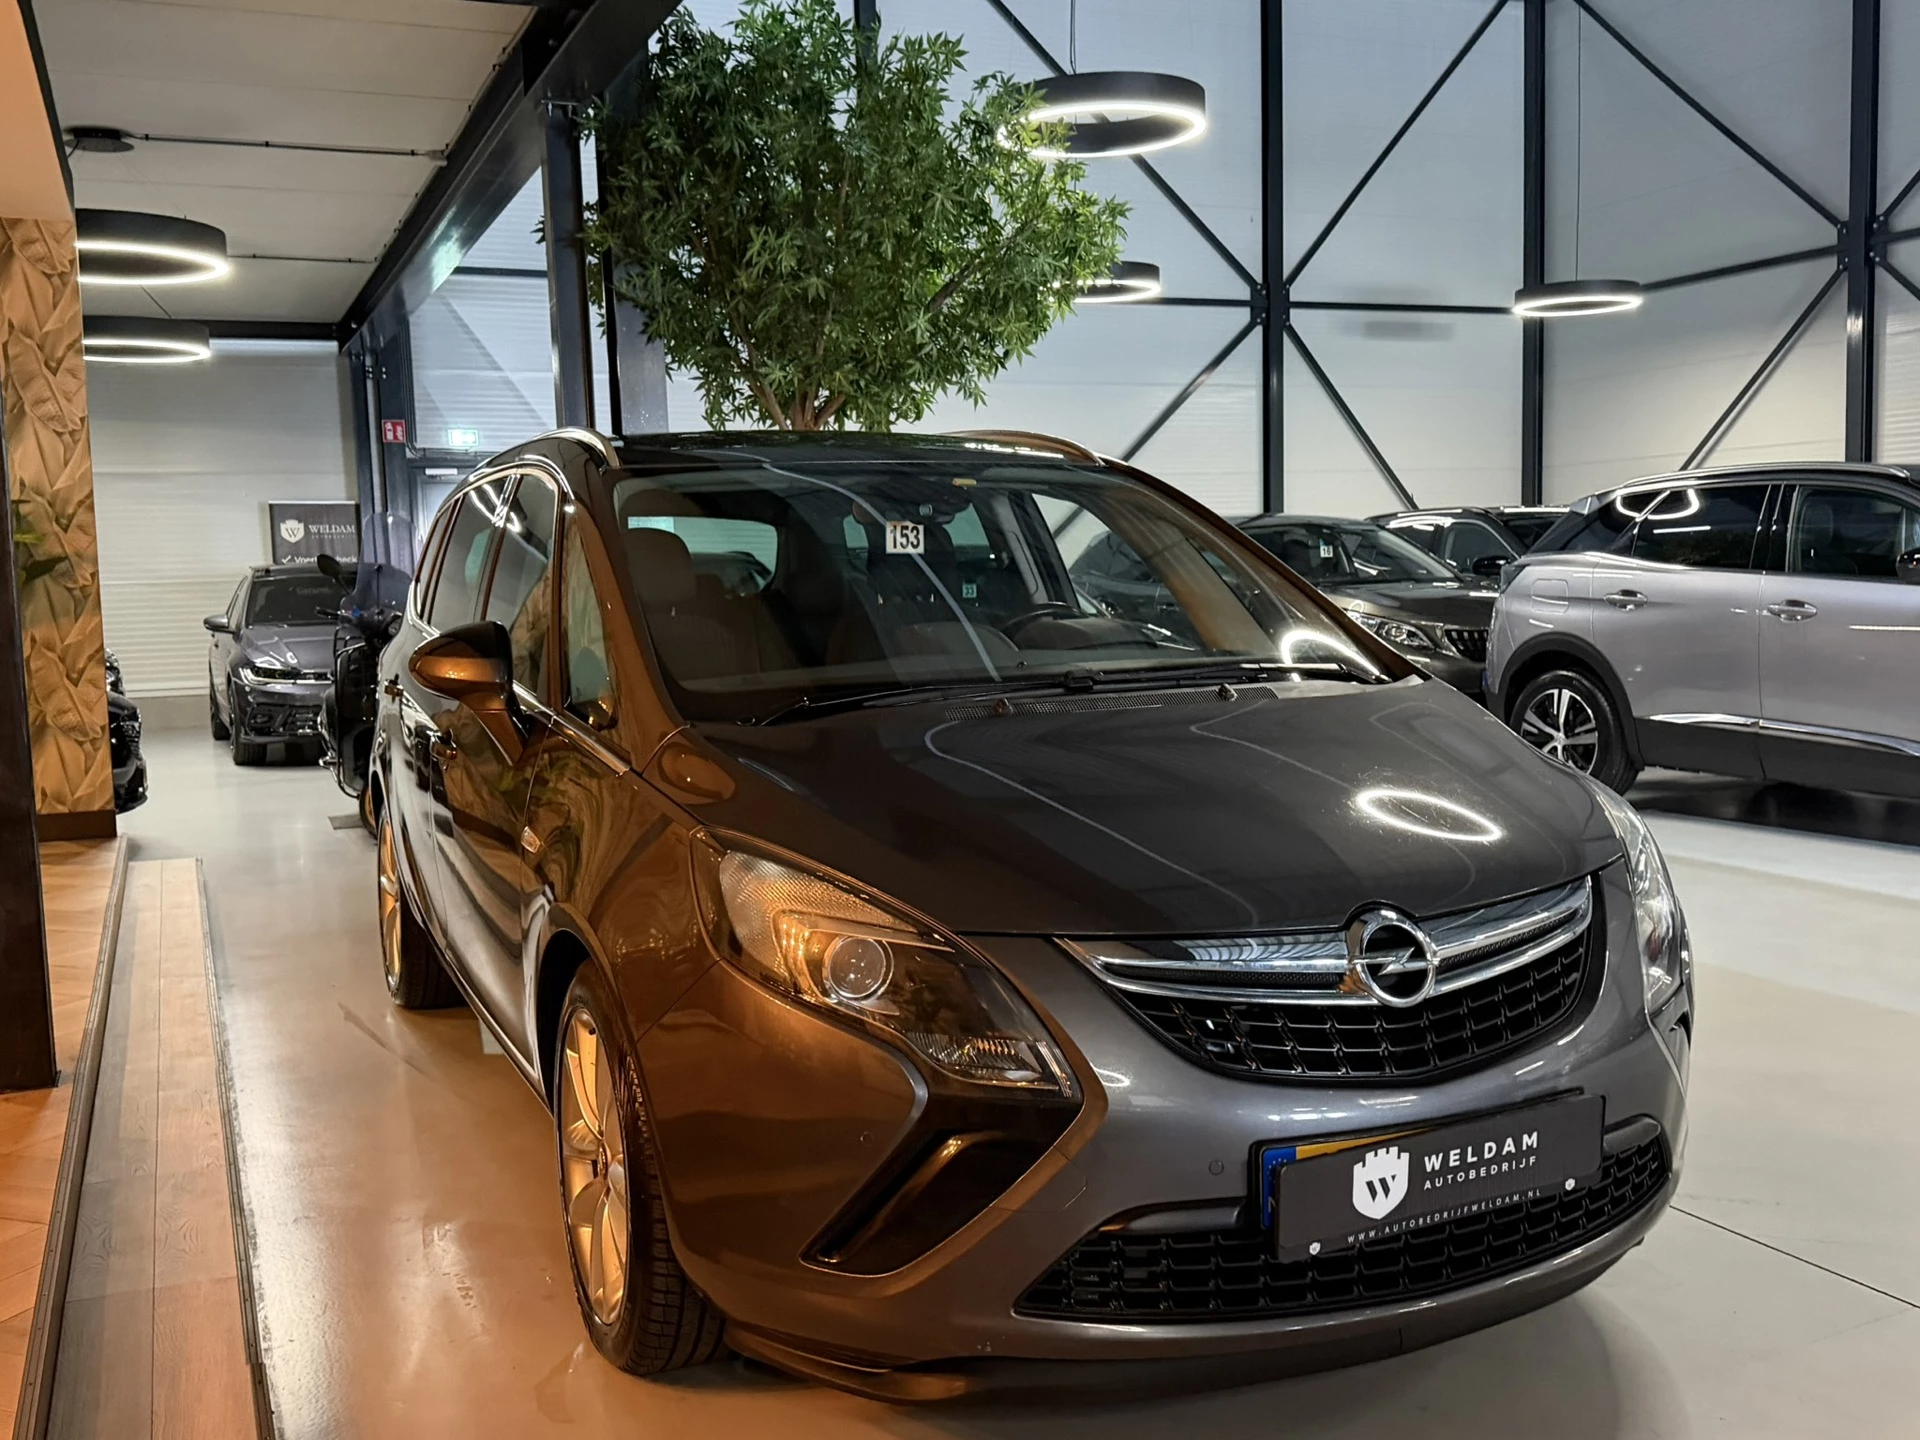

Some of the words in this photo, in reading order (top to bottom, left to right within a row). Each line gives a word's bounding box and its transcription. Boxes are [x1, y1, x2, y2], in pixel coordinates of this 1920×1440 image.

[308, 524, 356, 534] WELDAM
[889, 525, 921, 549] 153
[1424, 1131, 1538, 1172] WELDAM
[1365, 1174, 1397, 1203] W
[1423, 1156, 1537, 1191] AUTOBEDRIJF
[1347, 1188, 1540, 1244] WWW.AUTOBEDRIJFWELDAM.NL
